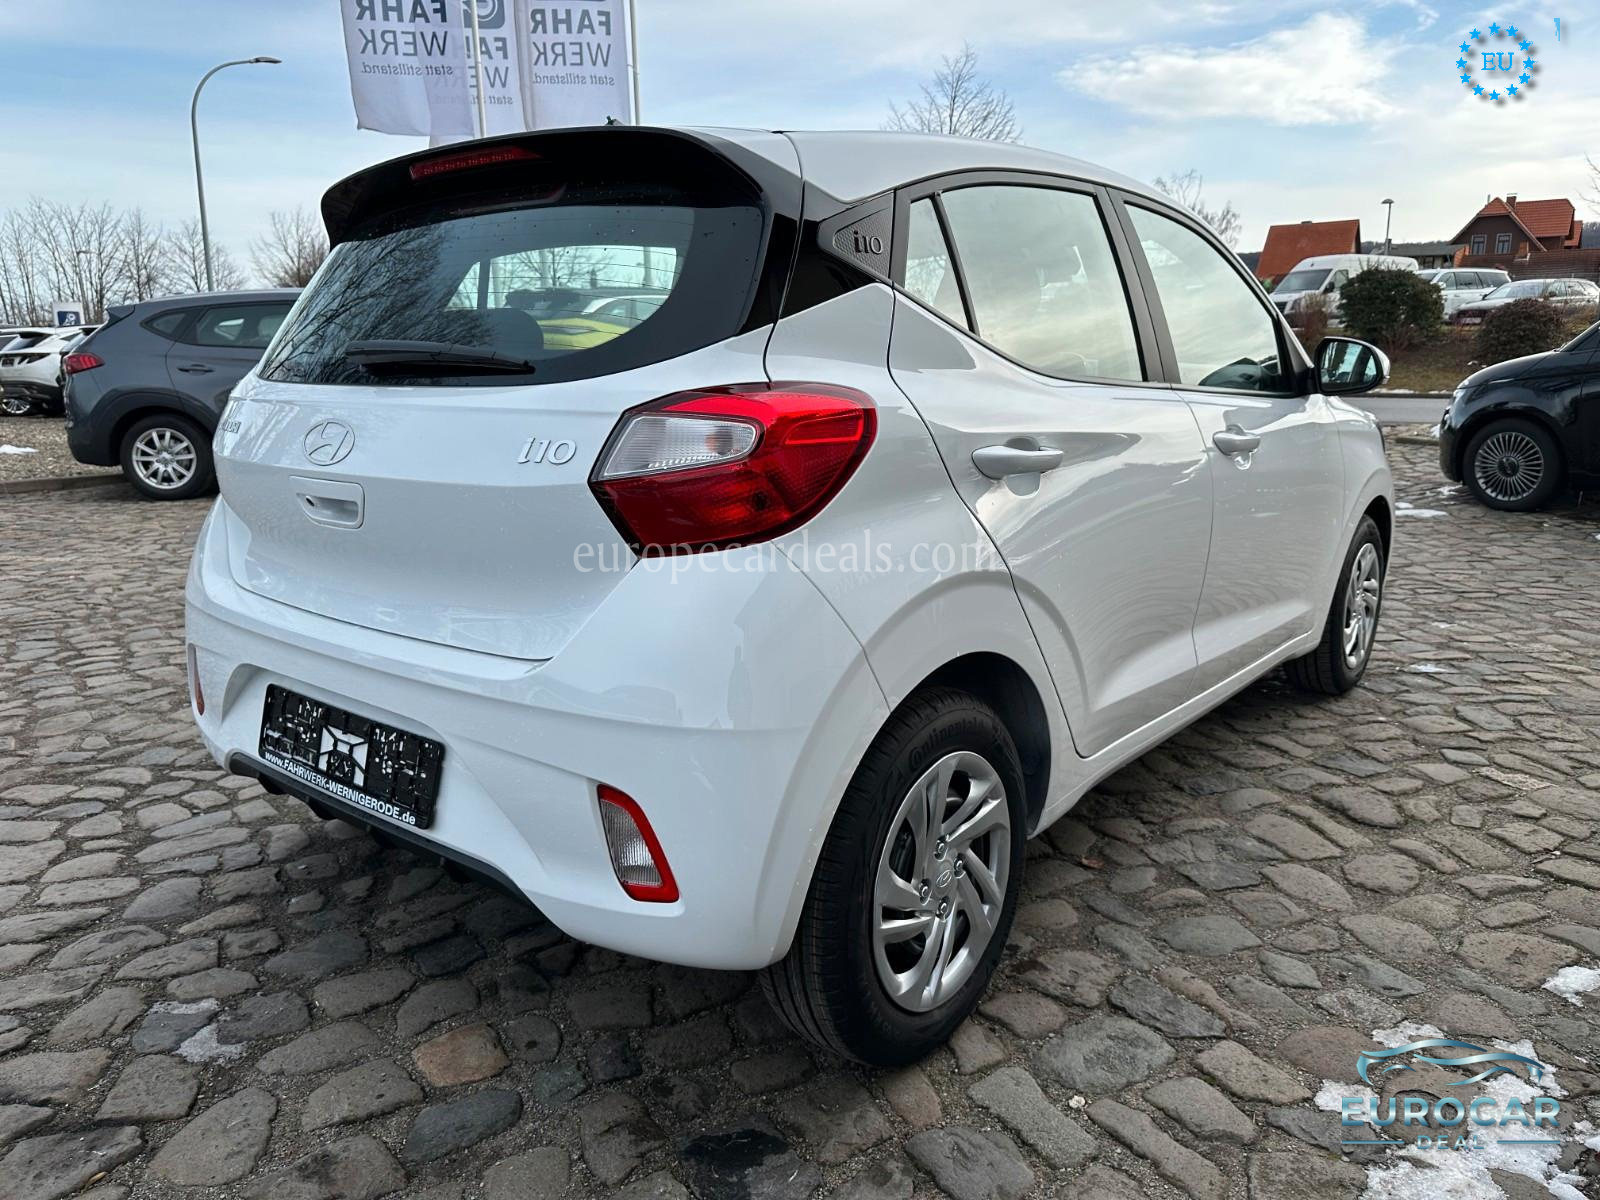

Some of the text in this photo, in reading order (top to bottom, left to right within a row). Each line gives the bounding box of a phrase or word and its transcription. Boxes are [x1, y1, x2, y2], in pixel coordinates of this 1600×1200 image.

[853, 229, 883, 255] i10
[517, 435, 577, 466] i10
[264, 751, 416, 825] www.FAHRWERK-WERNIGERODE.de
